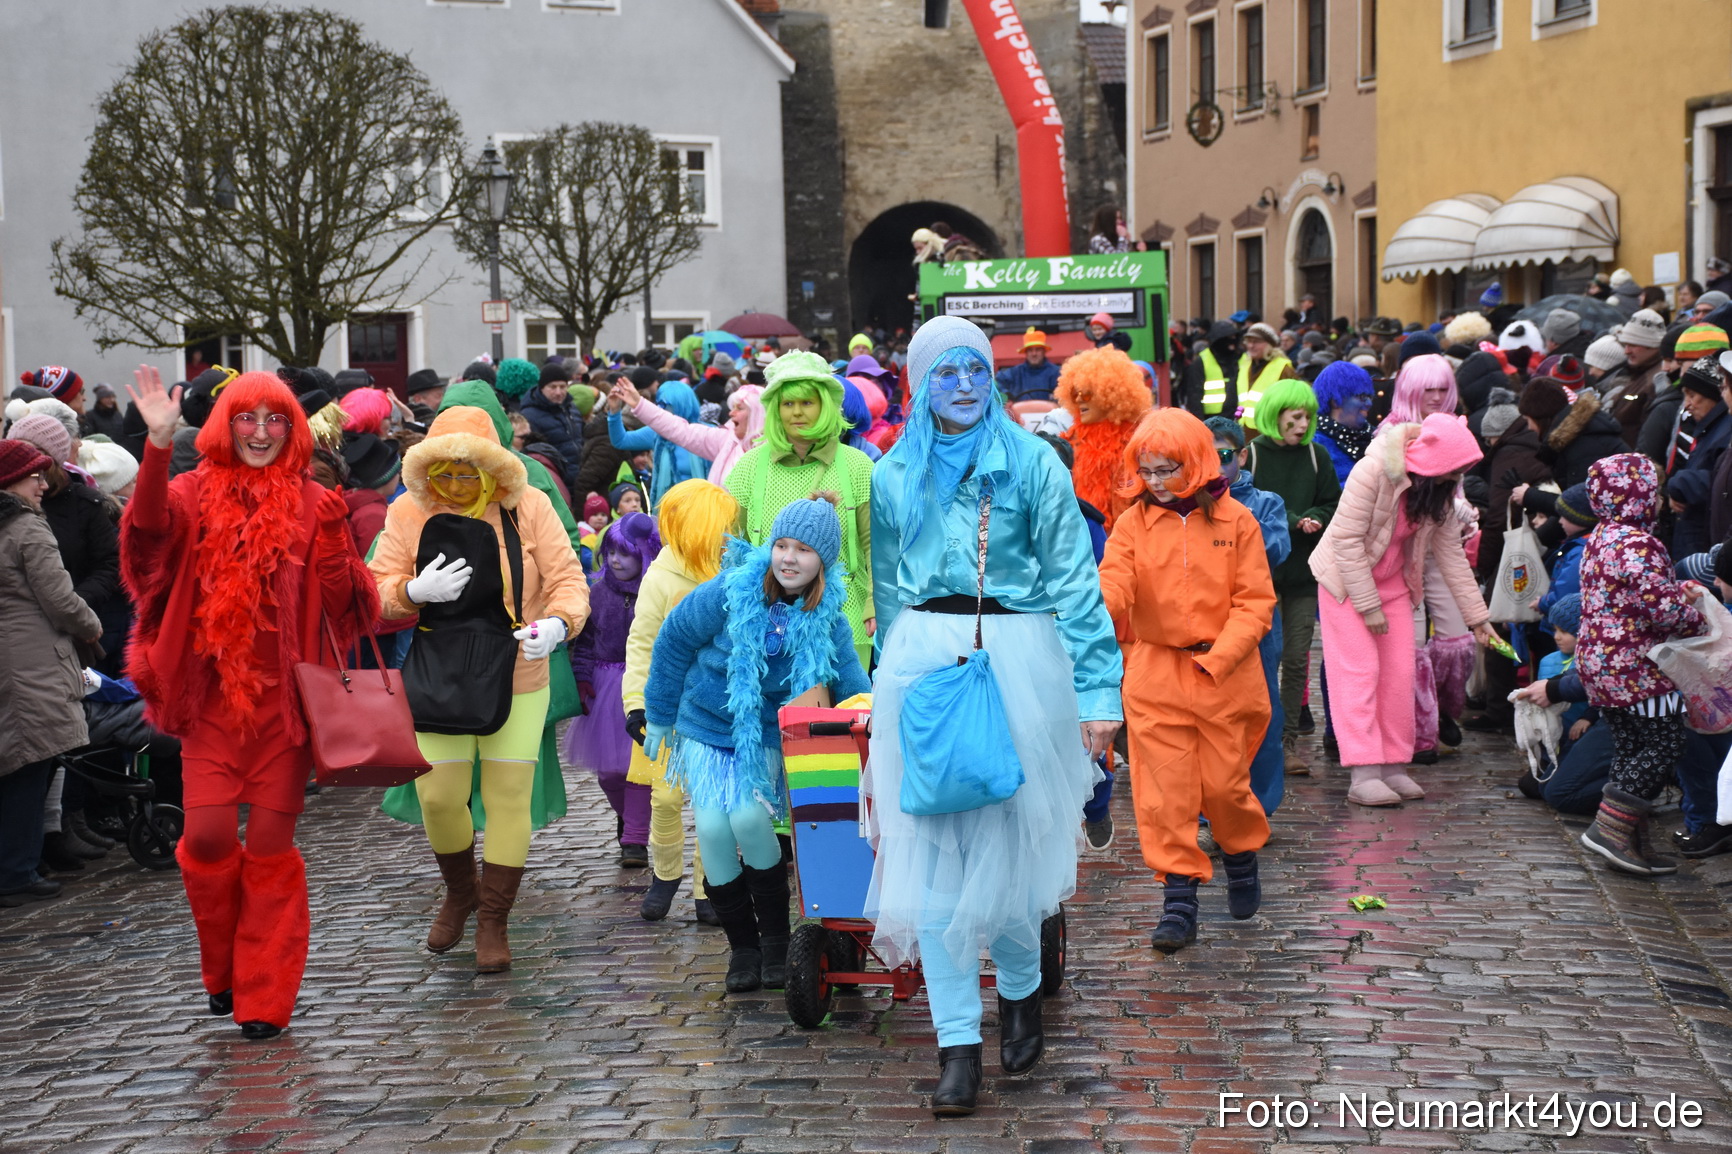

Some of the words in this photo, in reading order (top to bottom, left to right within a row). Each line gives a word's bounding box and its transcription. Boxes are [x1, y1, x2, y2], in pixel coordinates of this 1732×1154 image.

[943, 263, 962, 276] The
[963, 261, 1040, 290] Kelly
[1047, 256, 1143, 285] Family
[947, 301, 970, 310] ESC
[972, 300, 1024, 311] Berching
